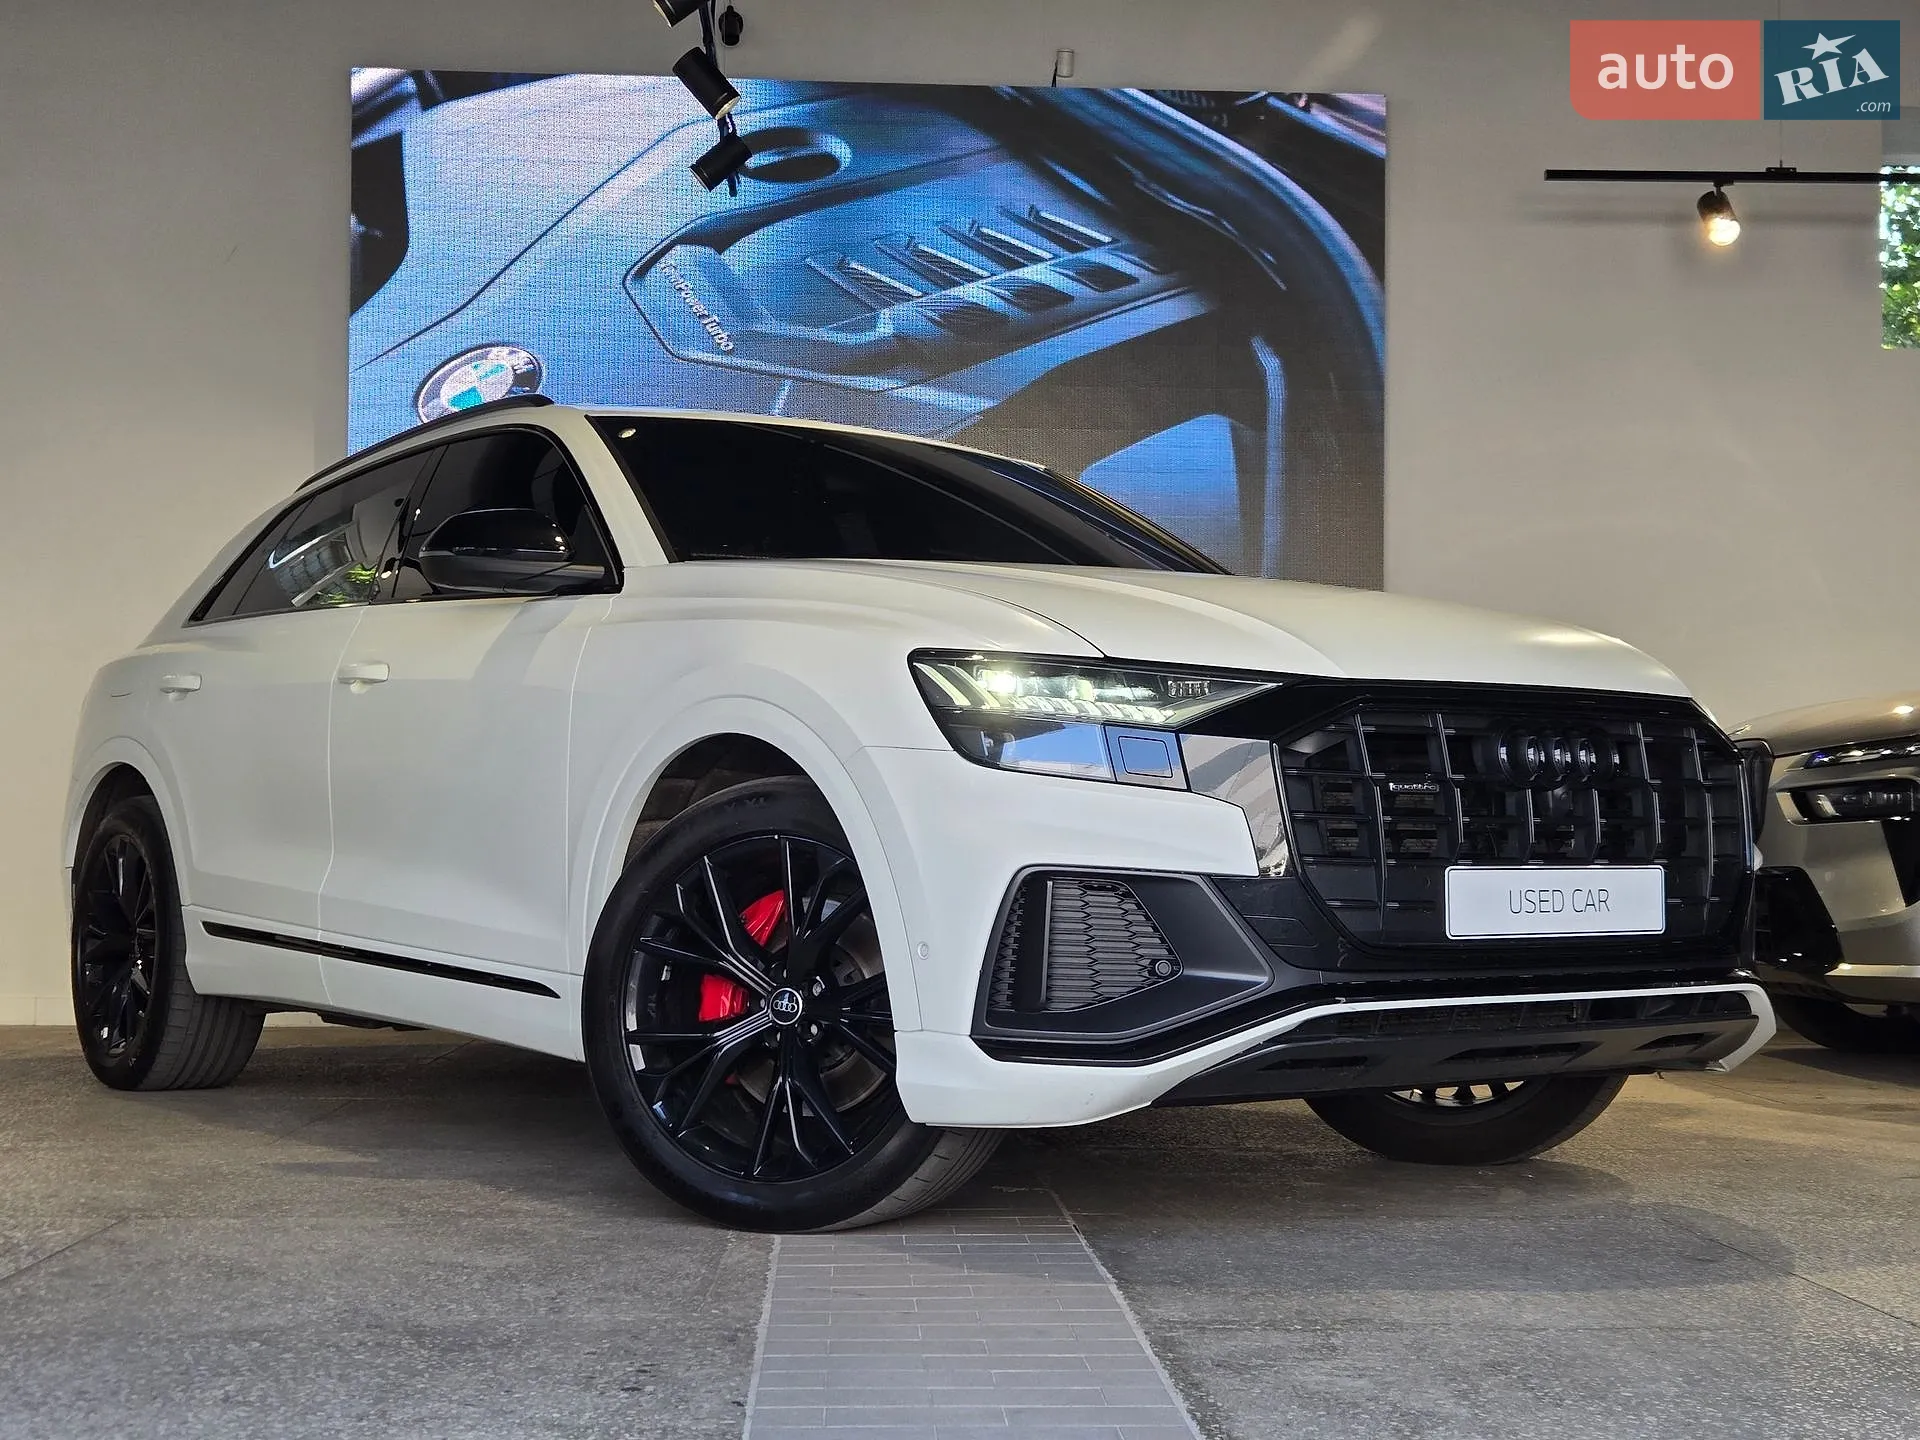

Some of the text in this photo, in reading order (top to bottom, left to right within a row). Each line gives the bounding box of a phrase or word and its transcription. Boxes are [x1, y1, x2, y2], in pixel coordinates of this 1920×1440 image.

[701, 315, 735, 352] Turbo
[1508, 888, 1611, 914] USED CAR
